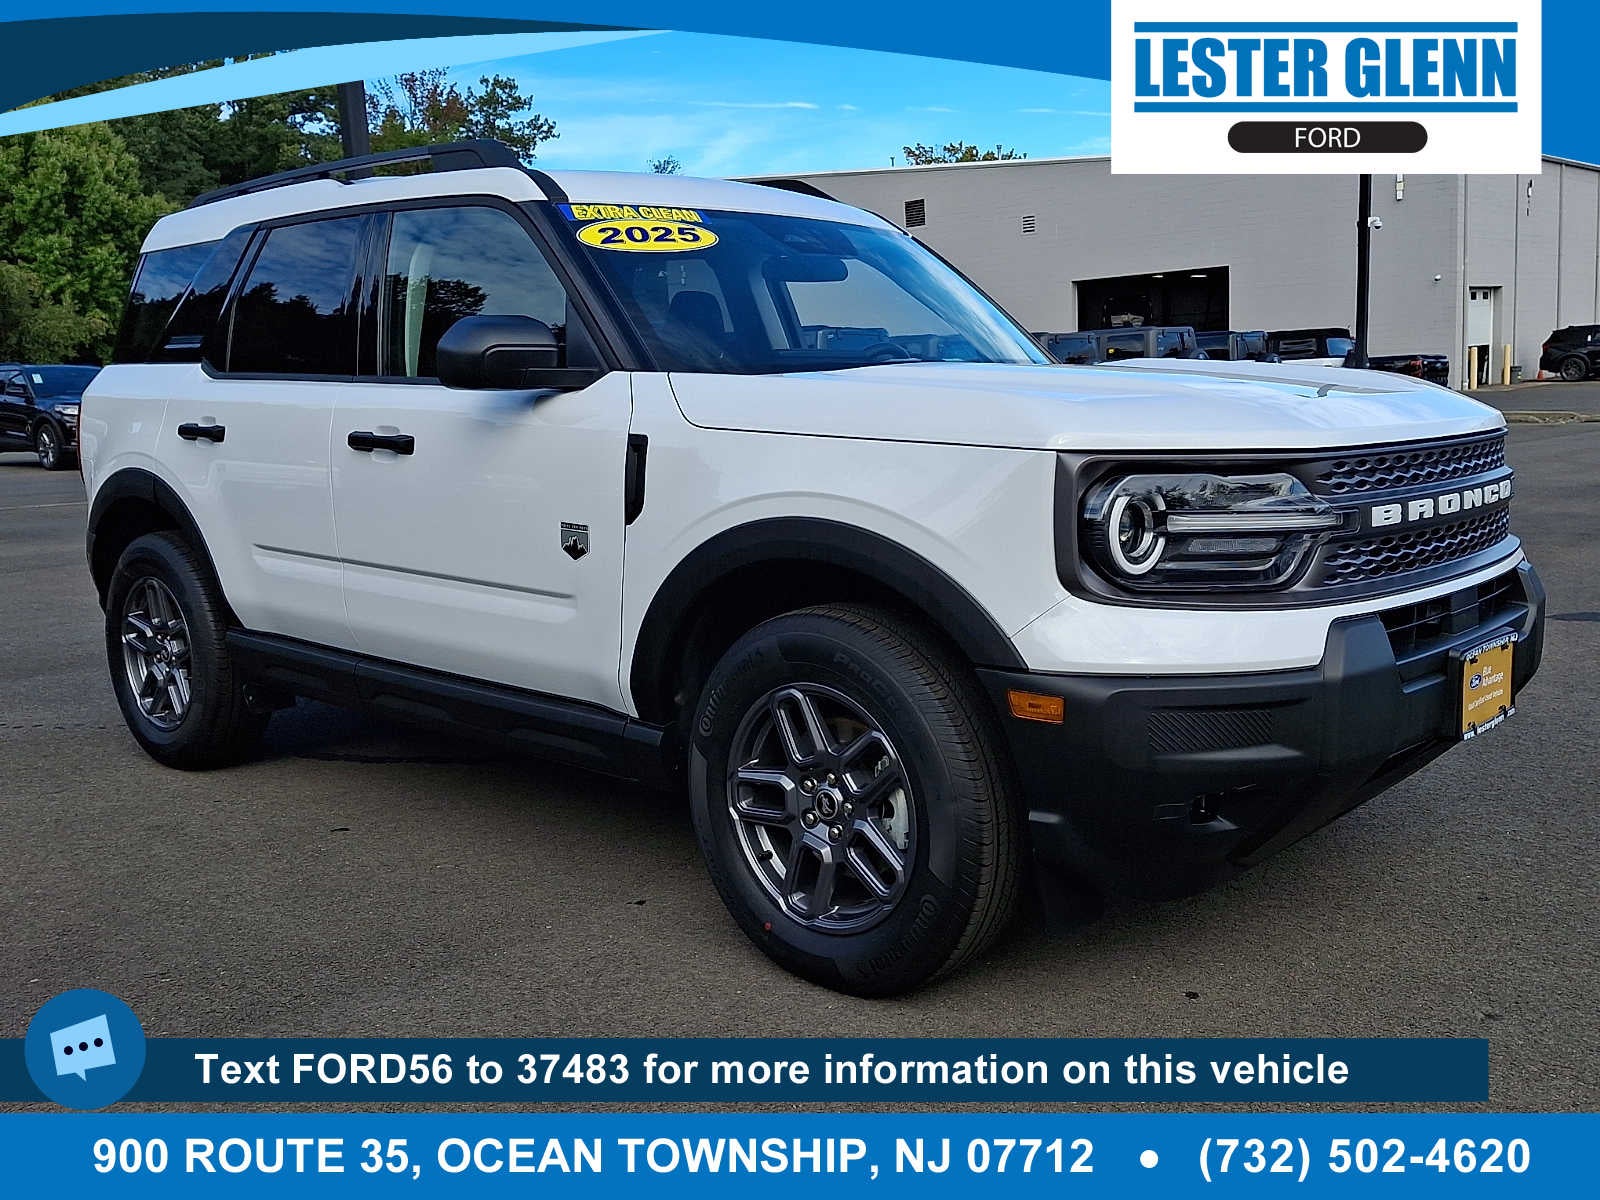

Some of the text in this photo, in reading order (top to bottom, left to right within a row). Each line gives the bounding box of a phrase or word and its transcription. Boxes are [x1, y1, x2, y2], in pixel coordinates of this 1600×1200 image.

[570, 204, 703, 223] EXTRA CLEAN
[597, 226, 702, 245] 2025
[1371, 479, 1512, 528] BRONCO
